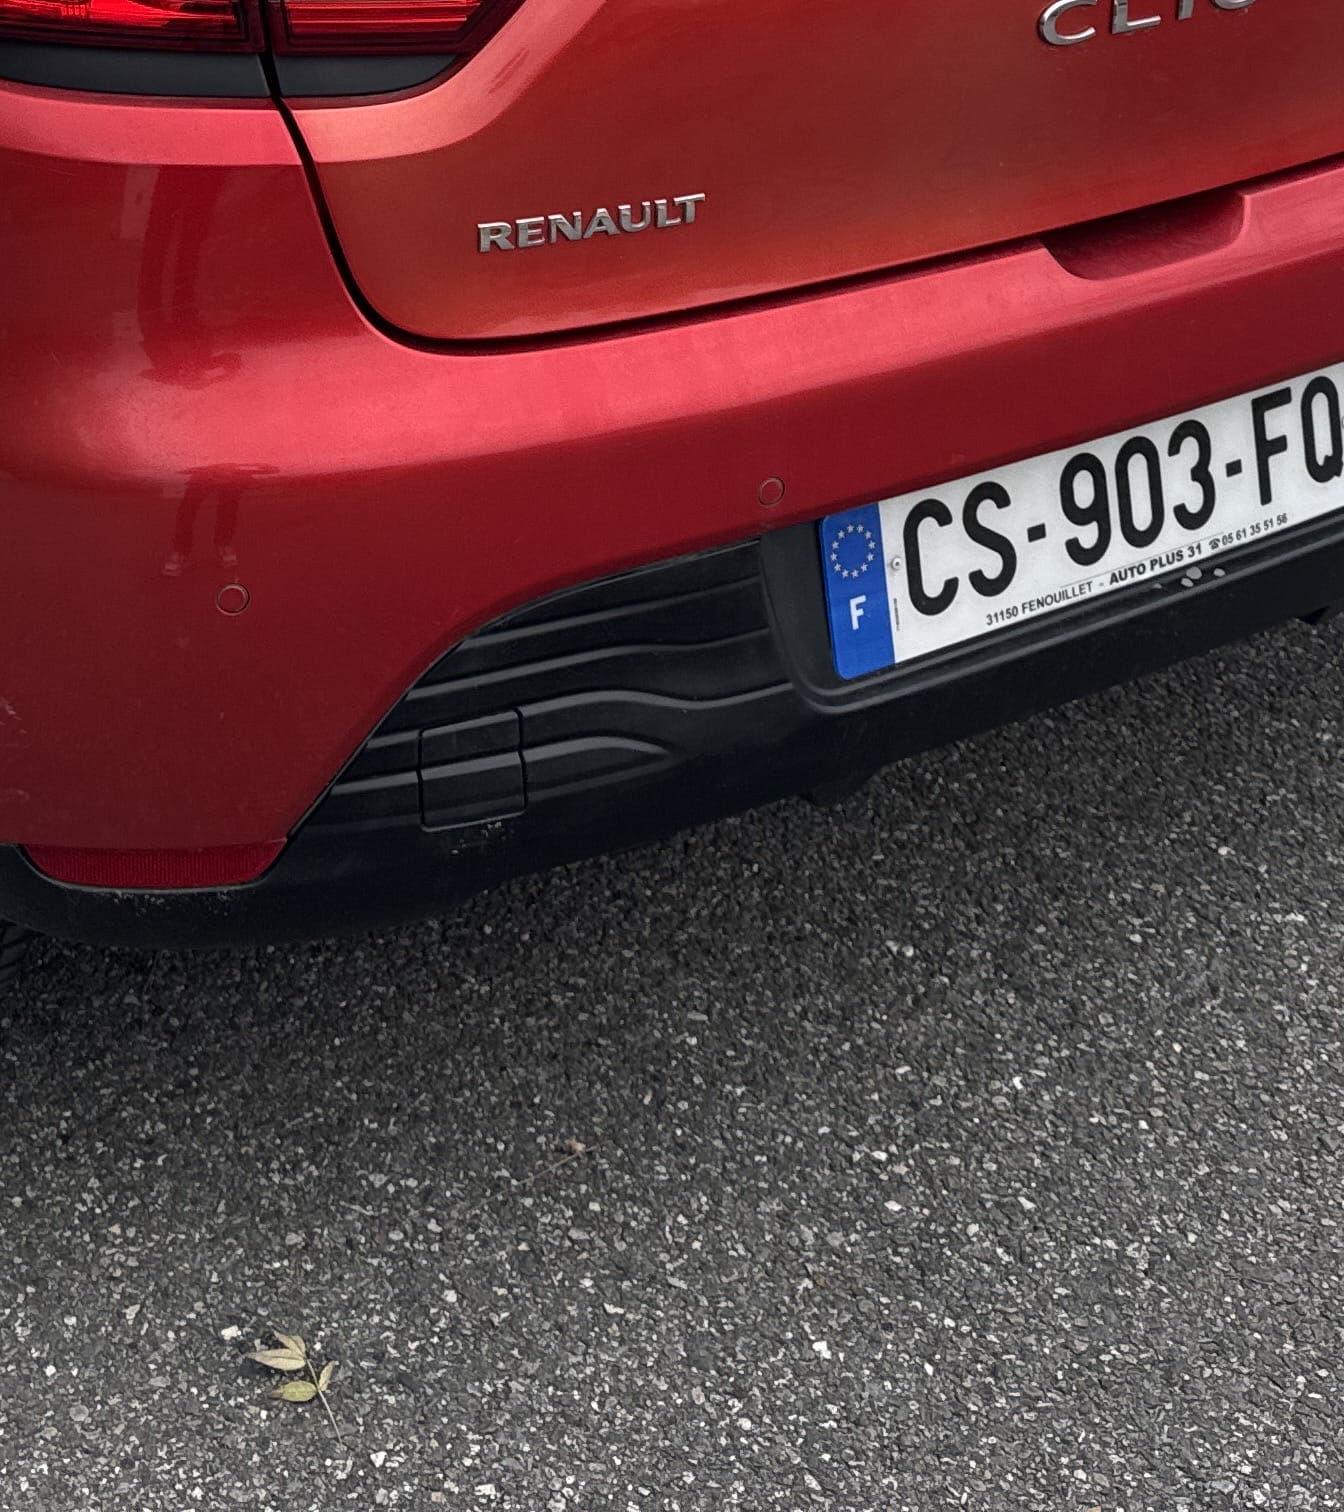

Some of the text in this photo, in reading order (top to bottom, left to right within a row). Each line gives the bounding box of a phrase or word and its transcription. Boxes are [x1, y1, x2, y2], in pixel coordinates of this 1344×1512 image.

[477, 193, 706, 253] RENAULT
[902, 375, 1344, 616] CS-903-FQ
[849, 594, 867, 631] F
[986, 605, 1019, 626] 31150
[1021, 581, 1093, 614] FENOUILLET
[1109, 563, 1146, 585] AUTO
[1150, 550, 1184, 571] PLUS
[1187, 543, 1202, 558] 31
[1222, 532, 1234, 546] 05
[1236, 528, 1247, 541] 61
[1250, 522, 1261, 536] 35
